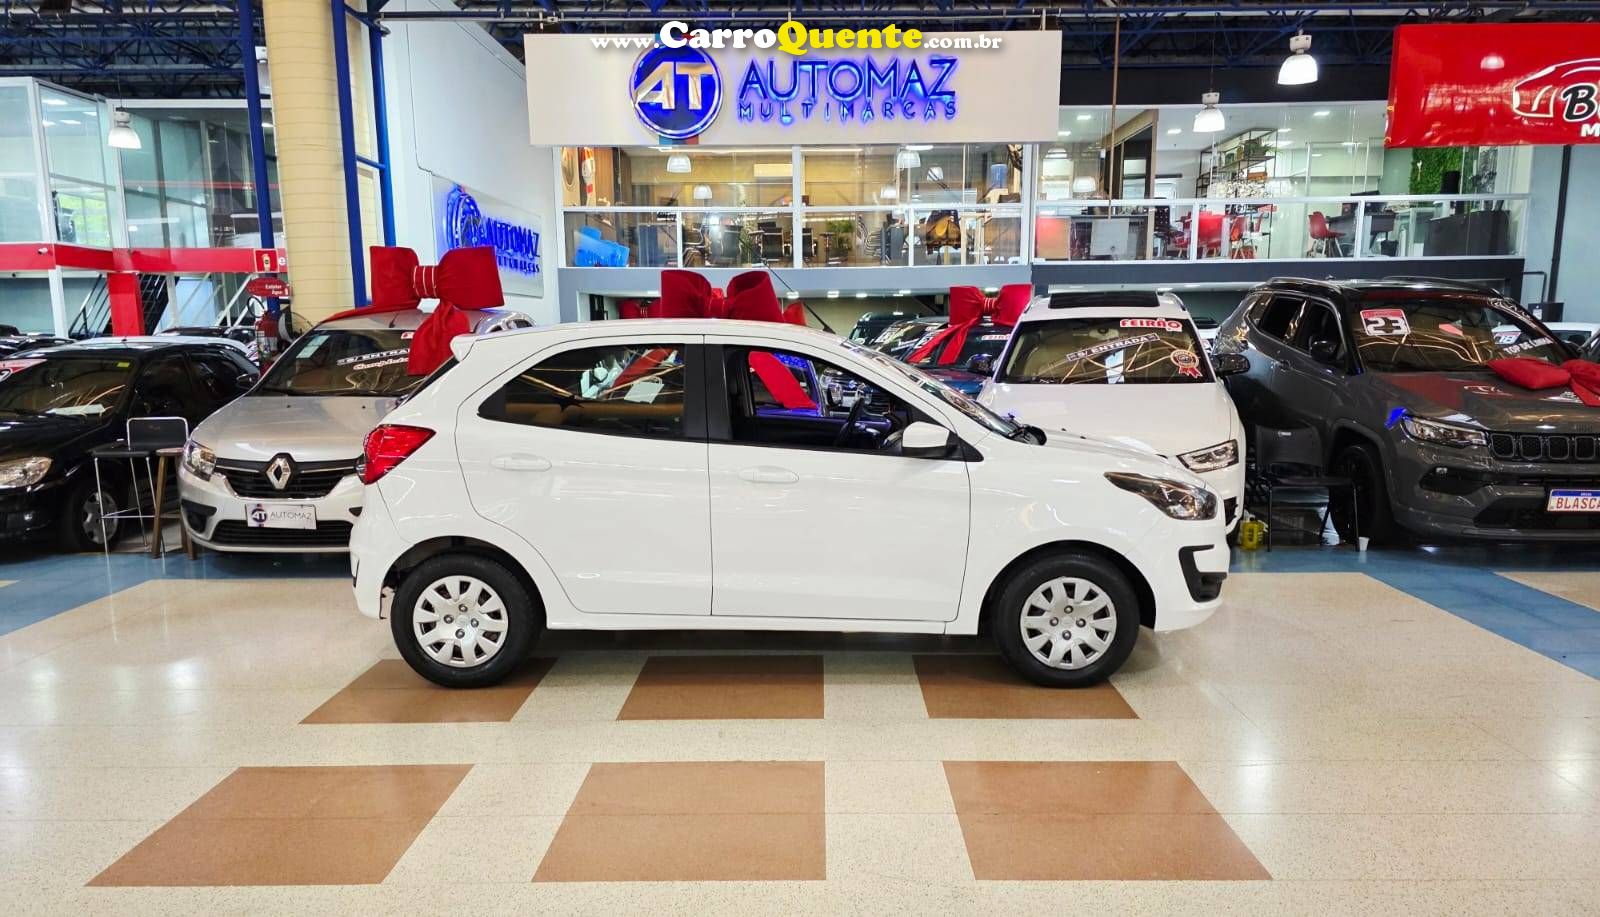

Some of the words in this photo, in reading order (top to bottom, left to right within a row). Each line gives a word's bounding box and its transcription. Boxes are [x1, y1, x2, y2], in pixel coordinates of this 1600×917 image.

[738, 58, 959, 100] AUTOMAZ
[738, 101, 957, 122] MULTIMARCAS
[1560, 82, 1600, 122] B
[1121, 317, 1181, 329] FEIRÃO
[1366, 315, 1409, 335] 23
[1091, 335, 1149, 355] ENTRADA
